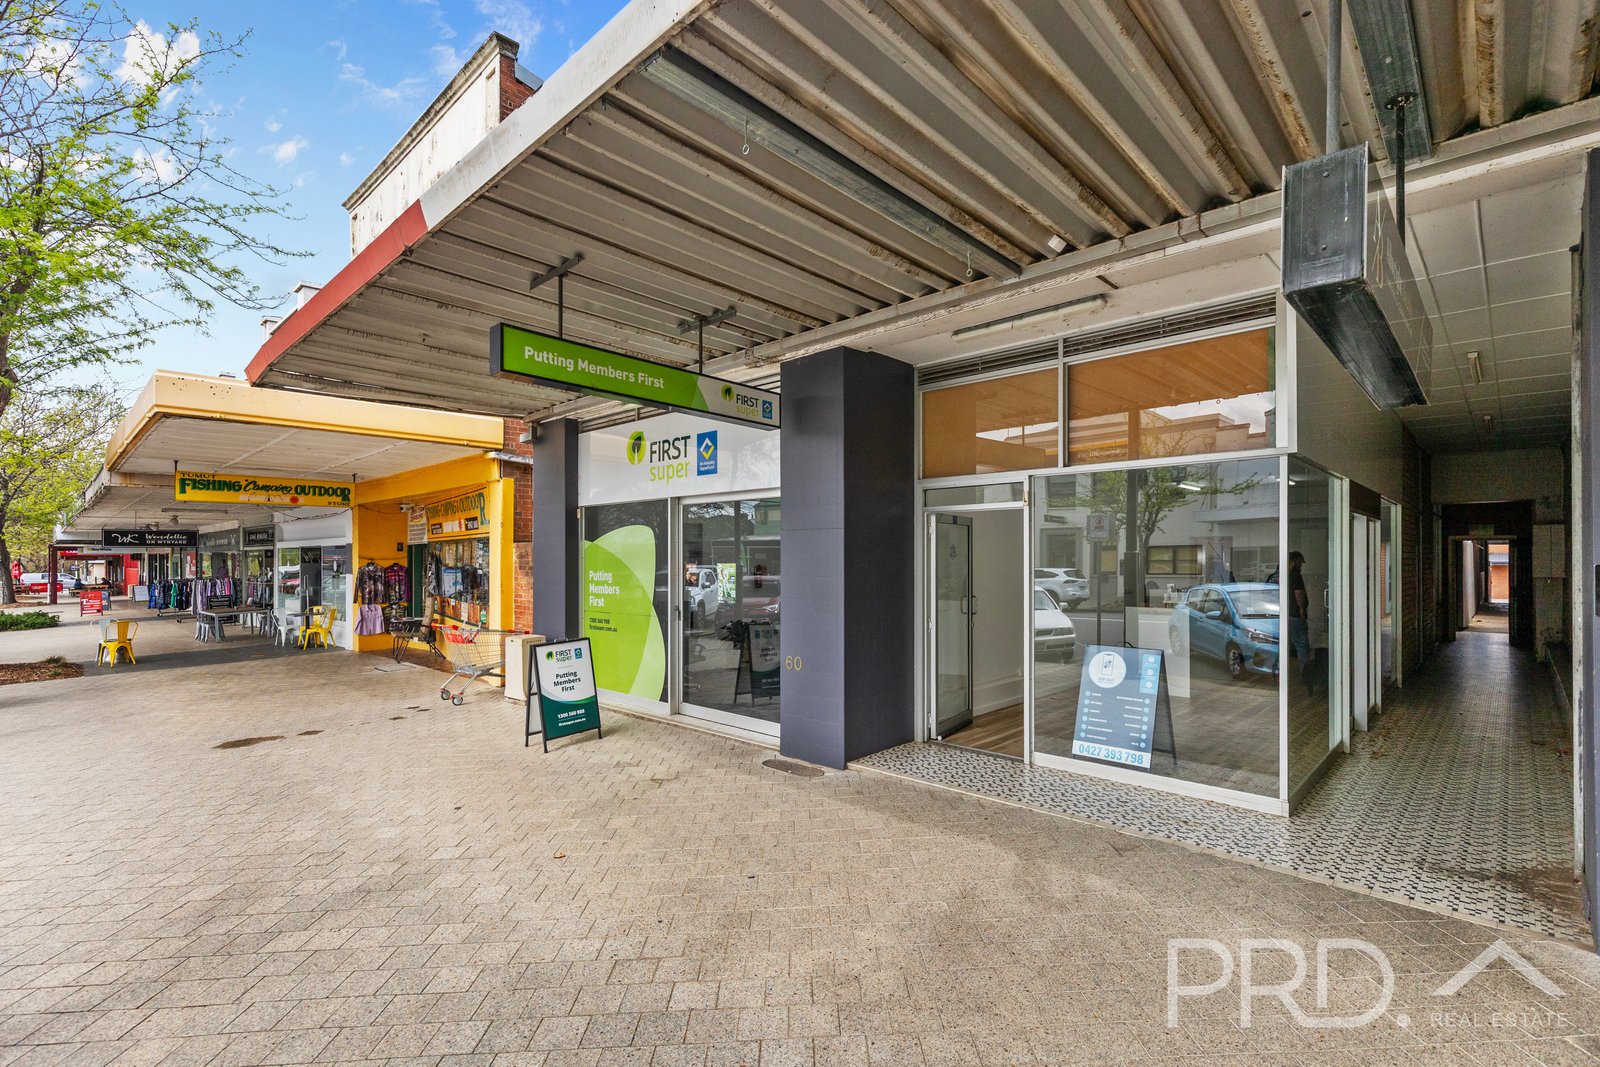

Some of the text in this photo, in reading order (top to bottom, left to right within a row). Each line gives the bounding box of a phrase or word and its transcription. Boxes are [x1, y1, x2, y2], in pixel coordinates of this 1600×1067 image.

[524, 345, 665, 389] Putting Members First
[736, 394, 760, 409] FIRST
[735, 406, 759, 417] super
[649, 435, 691, 463] FIRST
[649, 461, 691, 485] super
[178, 477, 352, 502] FISHING Camping OUTDOOR
[589, 570, 613, 583] Putting
[589, 583, 620, 595] Members
[589, 596, 605, 607] First
[555, 649, 572, 657] FIRST
[785, 655, 803, 671] 60
[553, 677, 581, 687] Members
[556, 671, 578, 679] Putting
[1078, 743, 1144, 765] 0427 393 798
